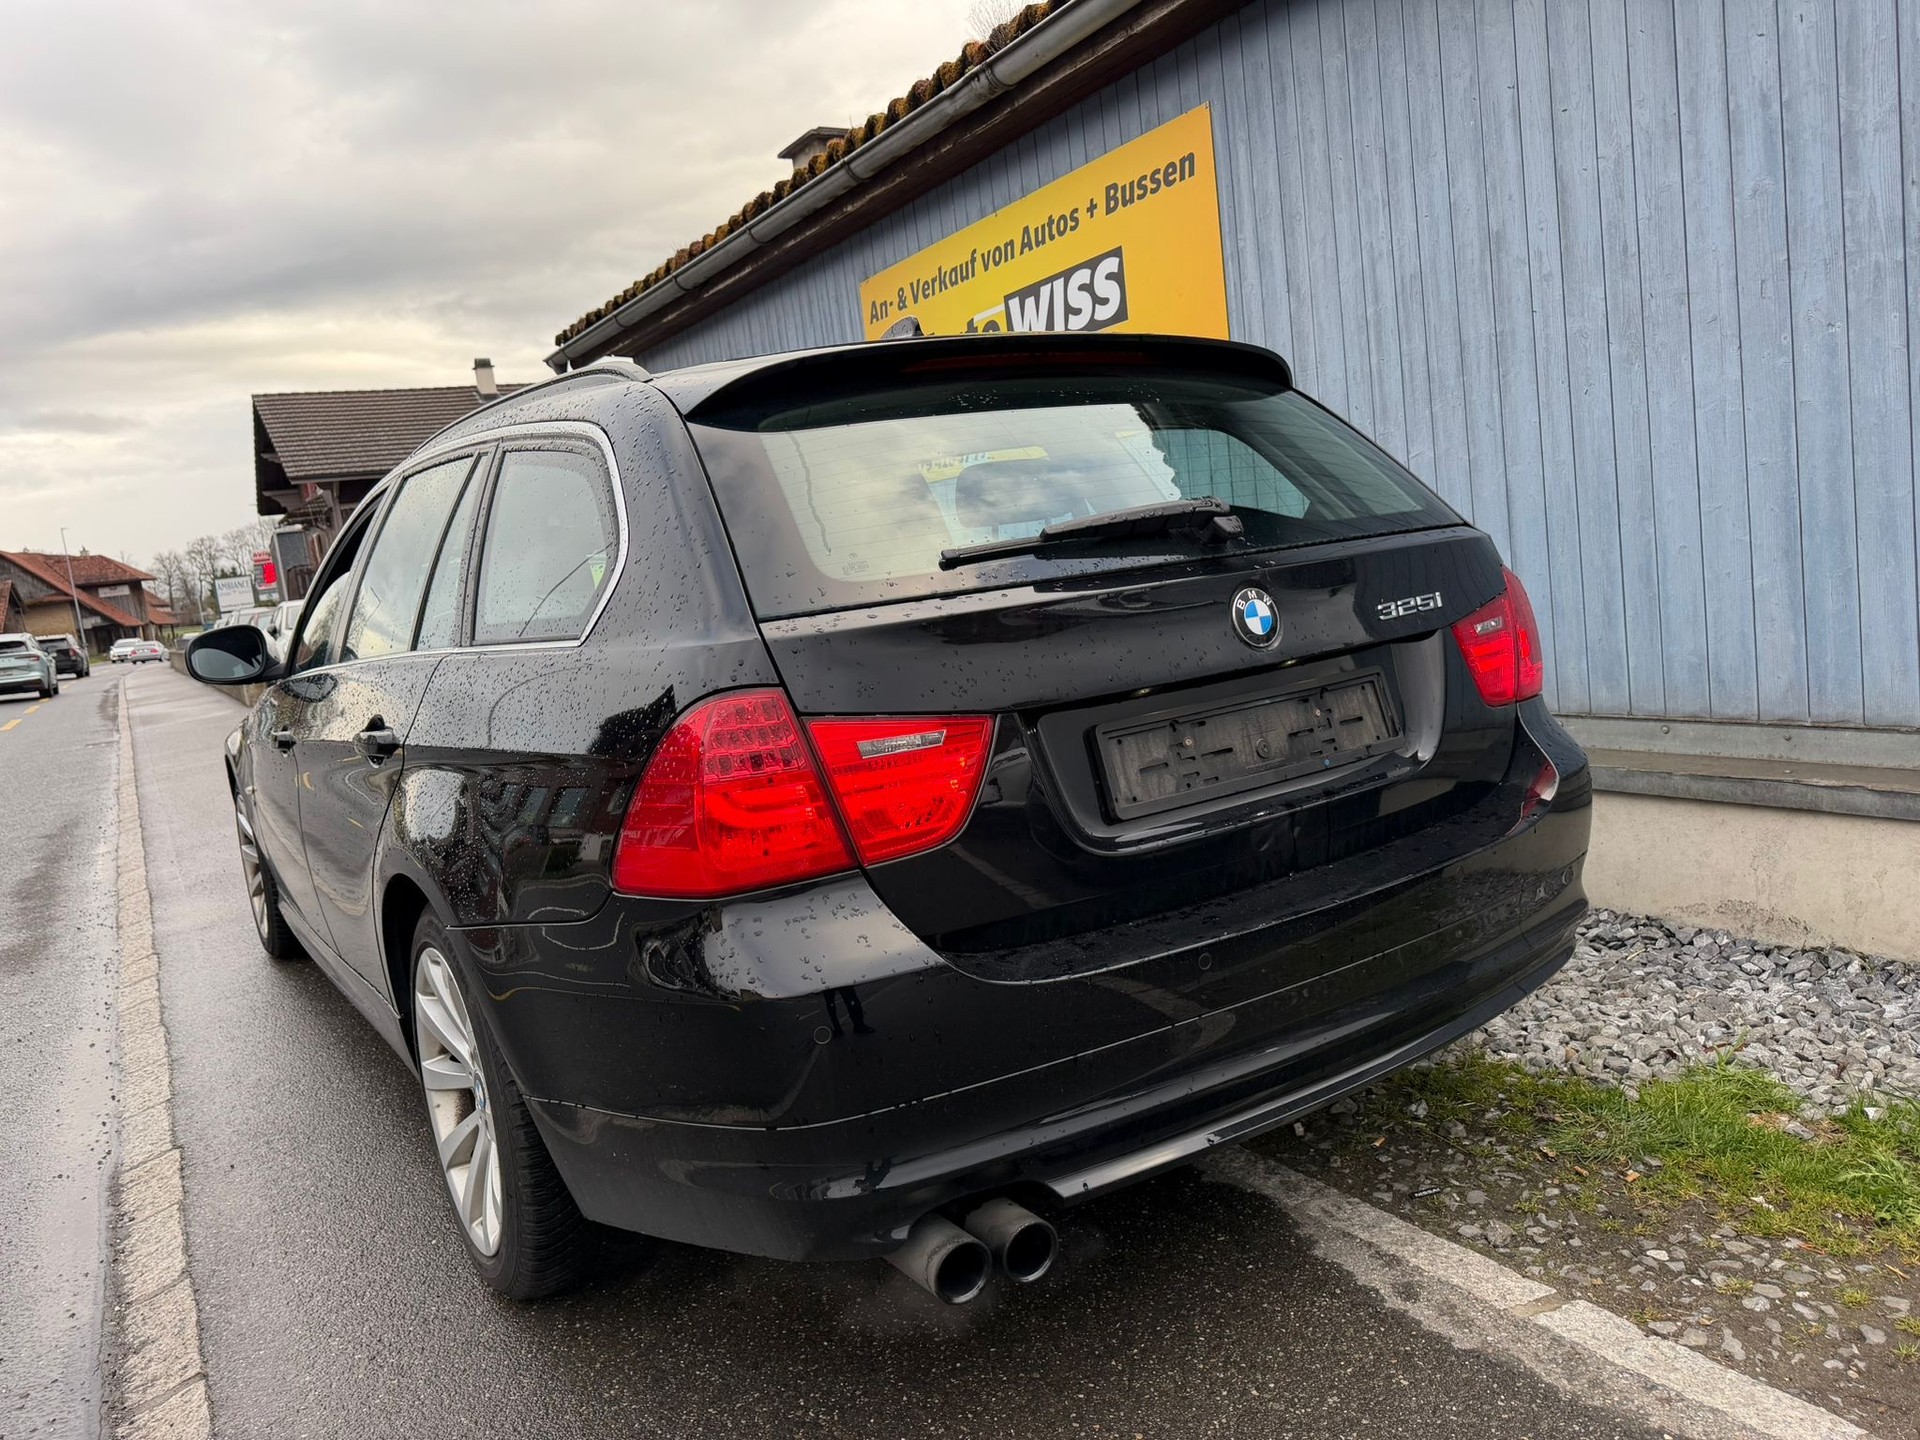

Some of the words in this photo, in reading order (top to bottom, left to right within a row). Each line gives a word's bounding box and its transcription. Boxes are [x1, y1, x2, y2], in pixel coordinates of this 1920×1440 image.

[870, 300, 894, 325] An-
[897, 287, 908, 311] &
[909, 248, 977, 305] Verkauf
[981, 238, 1016, 272] von
[1019, 207, 1080, 256] Autos
[1086, 197, 1098, 219] +
[1105, 151, 1195, 216] Bussen
[1236, 590, 1272, 610] BMW
